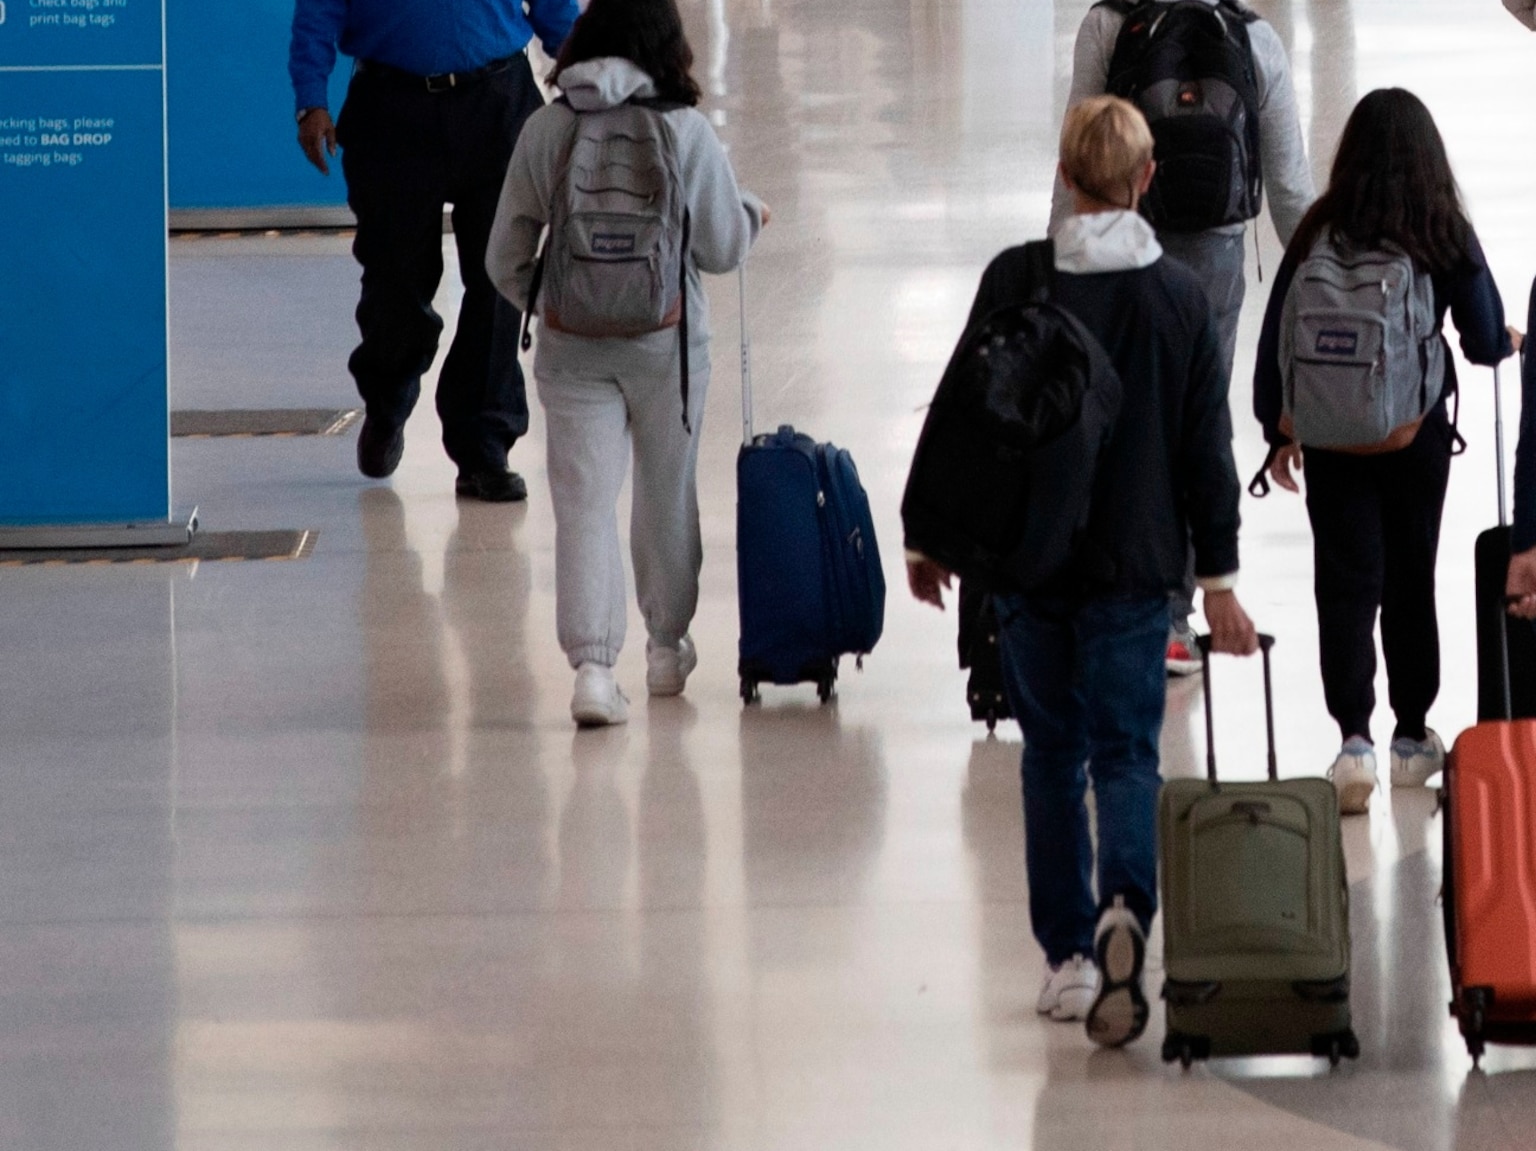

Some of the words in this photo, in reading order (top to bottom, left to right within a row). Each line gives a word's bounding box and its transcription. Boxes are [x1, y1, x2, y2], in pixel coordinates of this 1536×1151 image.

[30, 13, 59, 27] print
[63, 13, 86, 27] bag
[89, 13, 115, 27] tags
[74, 116, 114, 130] please
[24, 134, 37, 146] to
[40, 133, 70, 145] BAG
[73, 133, 112, 145] DROP
[4, 152, 51, 167] tagging
[53, 150, 83, 166] bags
